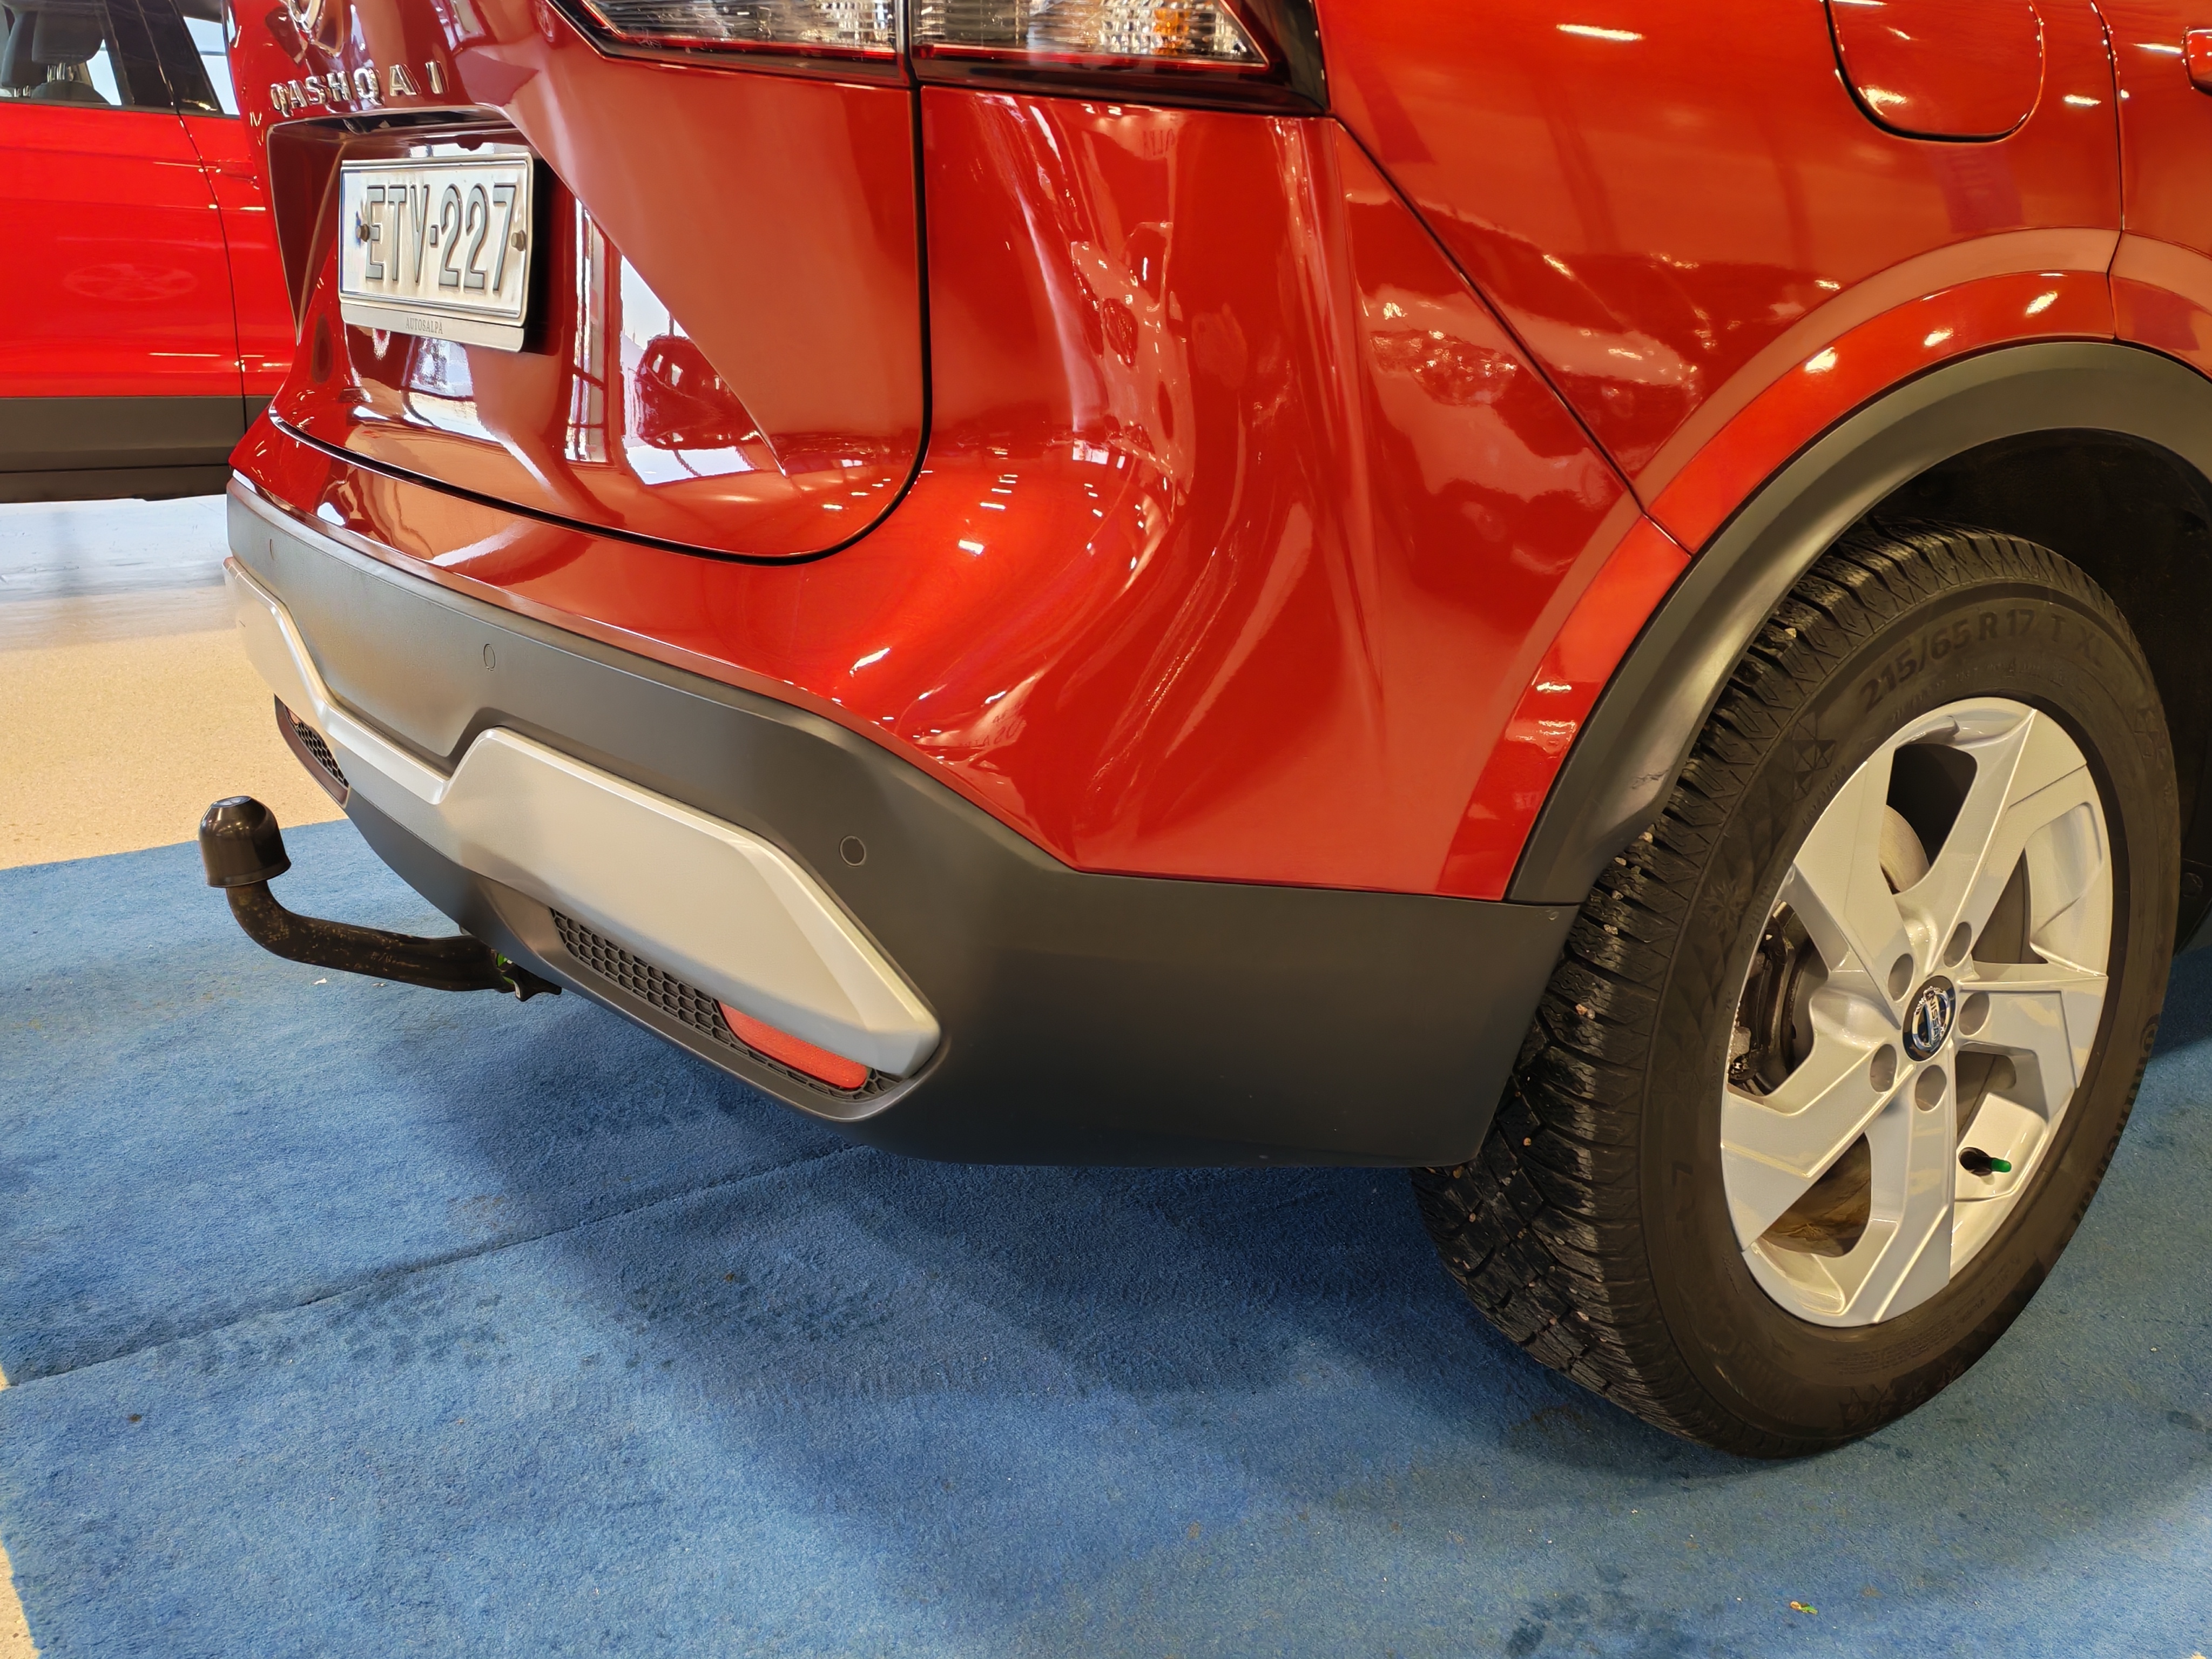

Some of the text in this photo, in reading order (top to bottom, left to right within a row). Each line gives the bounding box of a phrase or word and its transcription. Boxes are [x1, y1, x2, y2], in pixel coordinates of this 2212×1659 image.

[270, 59, 449, 117] QASHQAI
[365, 183, 518, 293] ETV-227
[405, 316, 443, 335] AUTOSALPA
[1861, 618, 1970, 711] 215/65
[1979, 611, 1998, 638] R
[2007, 609, 2034, 636] 17
[1929, 999, 1940, 1045] NISSAN
